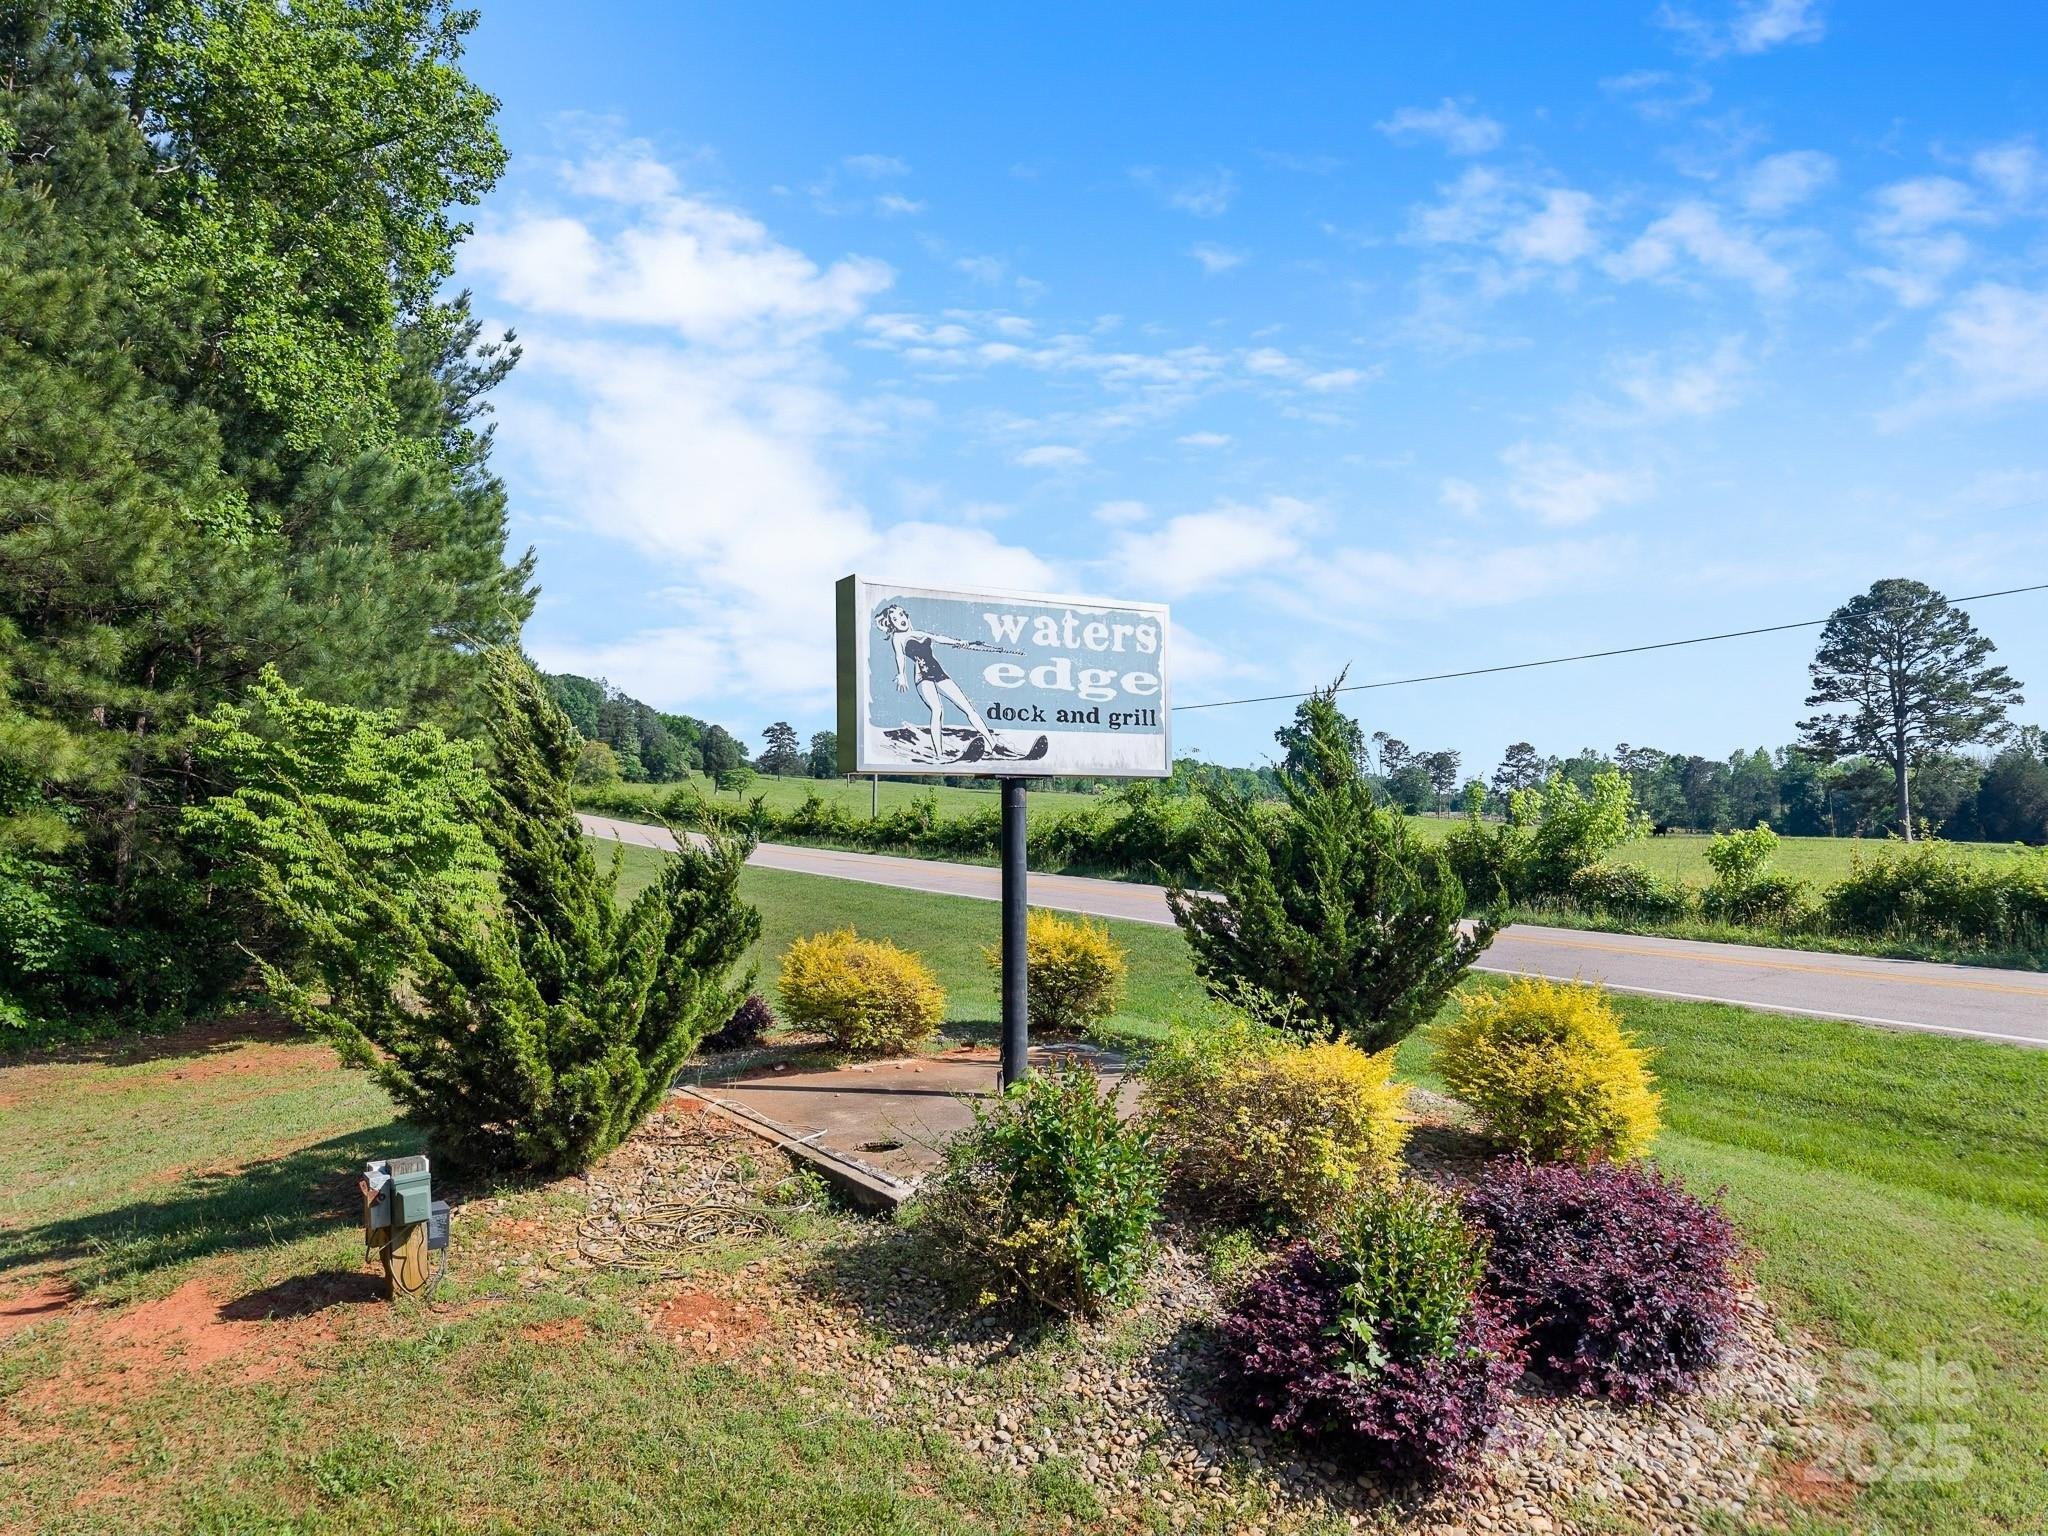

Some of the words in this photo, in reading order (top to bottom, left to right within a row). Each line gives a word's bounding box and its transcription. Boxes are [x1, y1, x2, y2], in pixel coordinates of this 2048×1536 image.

[983, 609, 1157, 654] waters
[982, 657, 1159, 701] edge
[986, 702, 1046, 723] dock
[1056, 706, 1100, 725] and
[1108, 708, 1156, 729] grill
